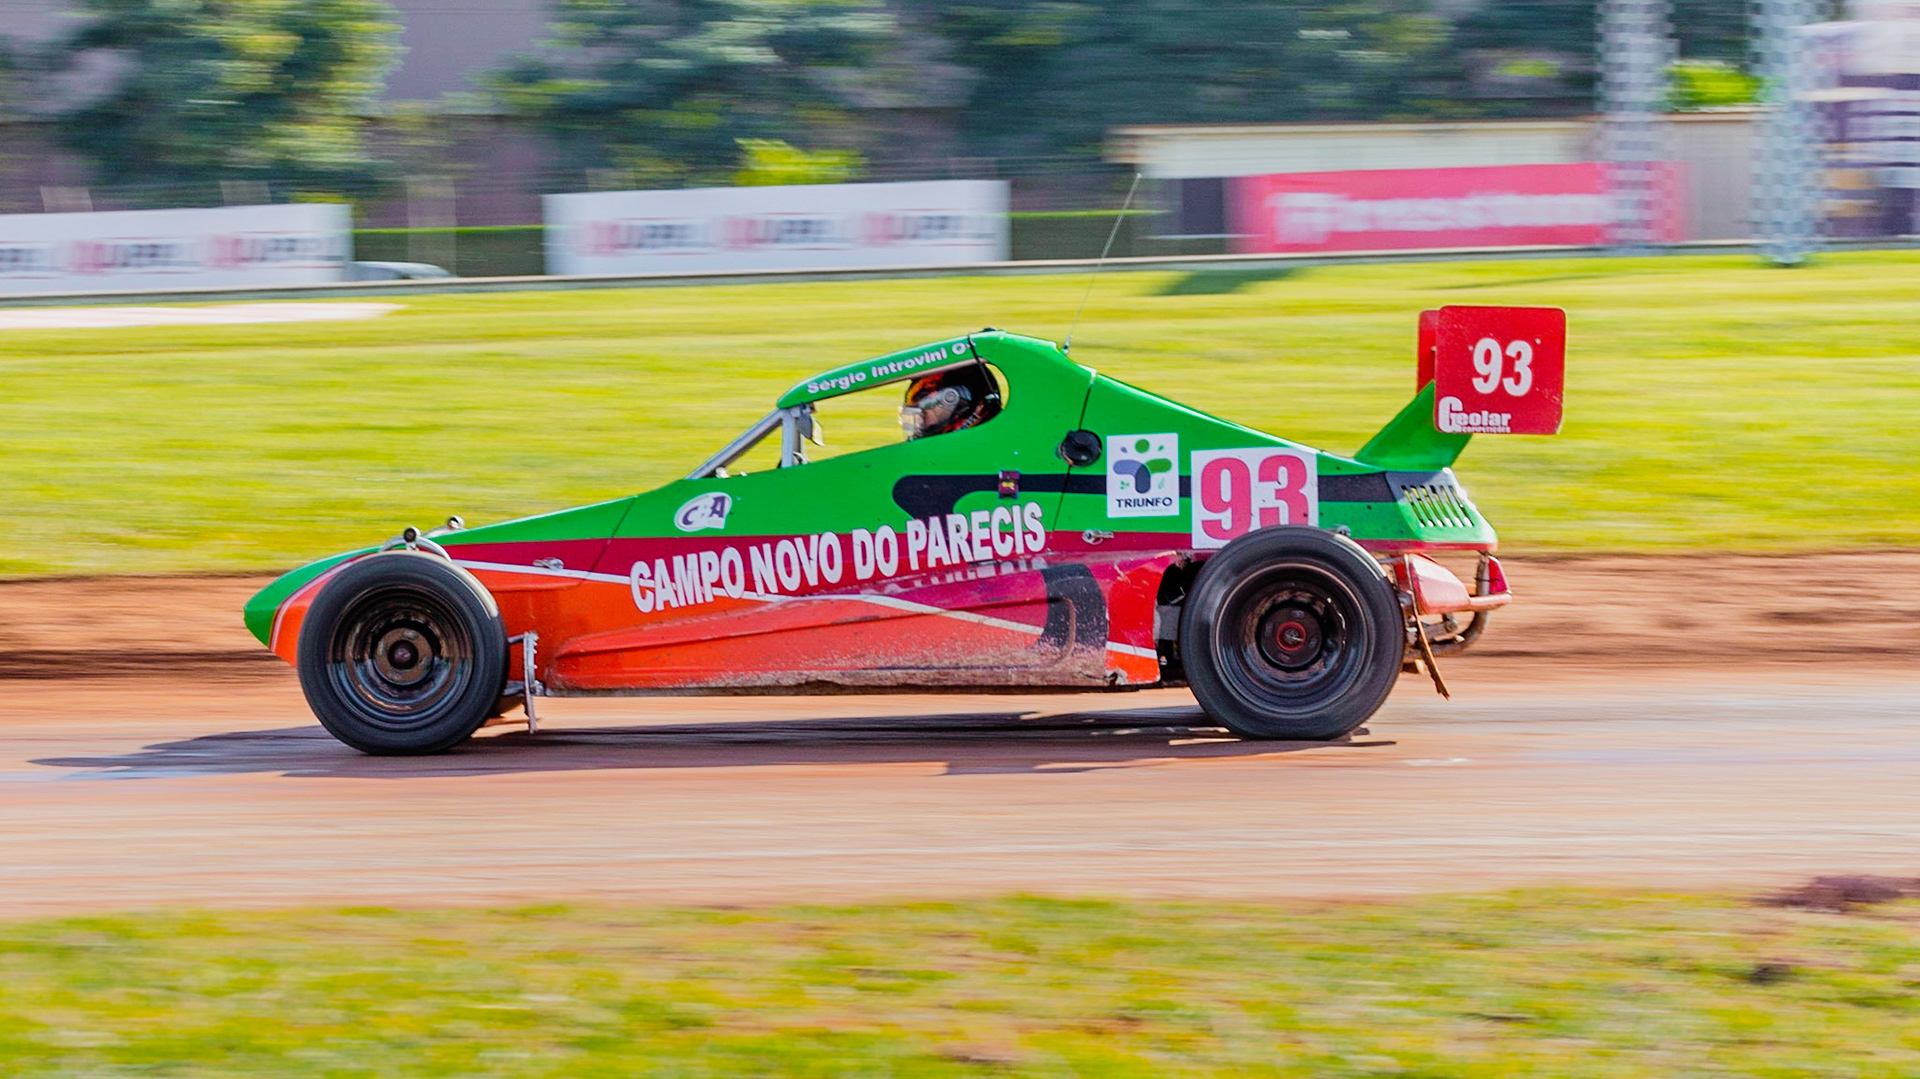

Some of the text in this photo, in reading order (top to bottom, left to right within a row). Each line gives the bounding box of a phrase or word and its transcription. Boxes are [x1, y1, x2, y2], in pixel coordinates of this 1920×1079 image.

[807, 372, 867, 394] Sérgio
[871, 347, 948, 378] Introvini
[1472, 337, 1533, 397] 93
[1438, 396, 1512, 433] Geolar
[1115, 496, 1173, 508] TRIUNFO
[1201, 455, 1309, 541] 93
[630, 502, 1046, 614] CAMPO NOVO DO PARECIS
